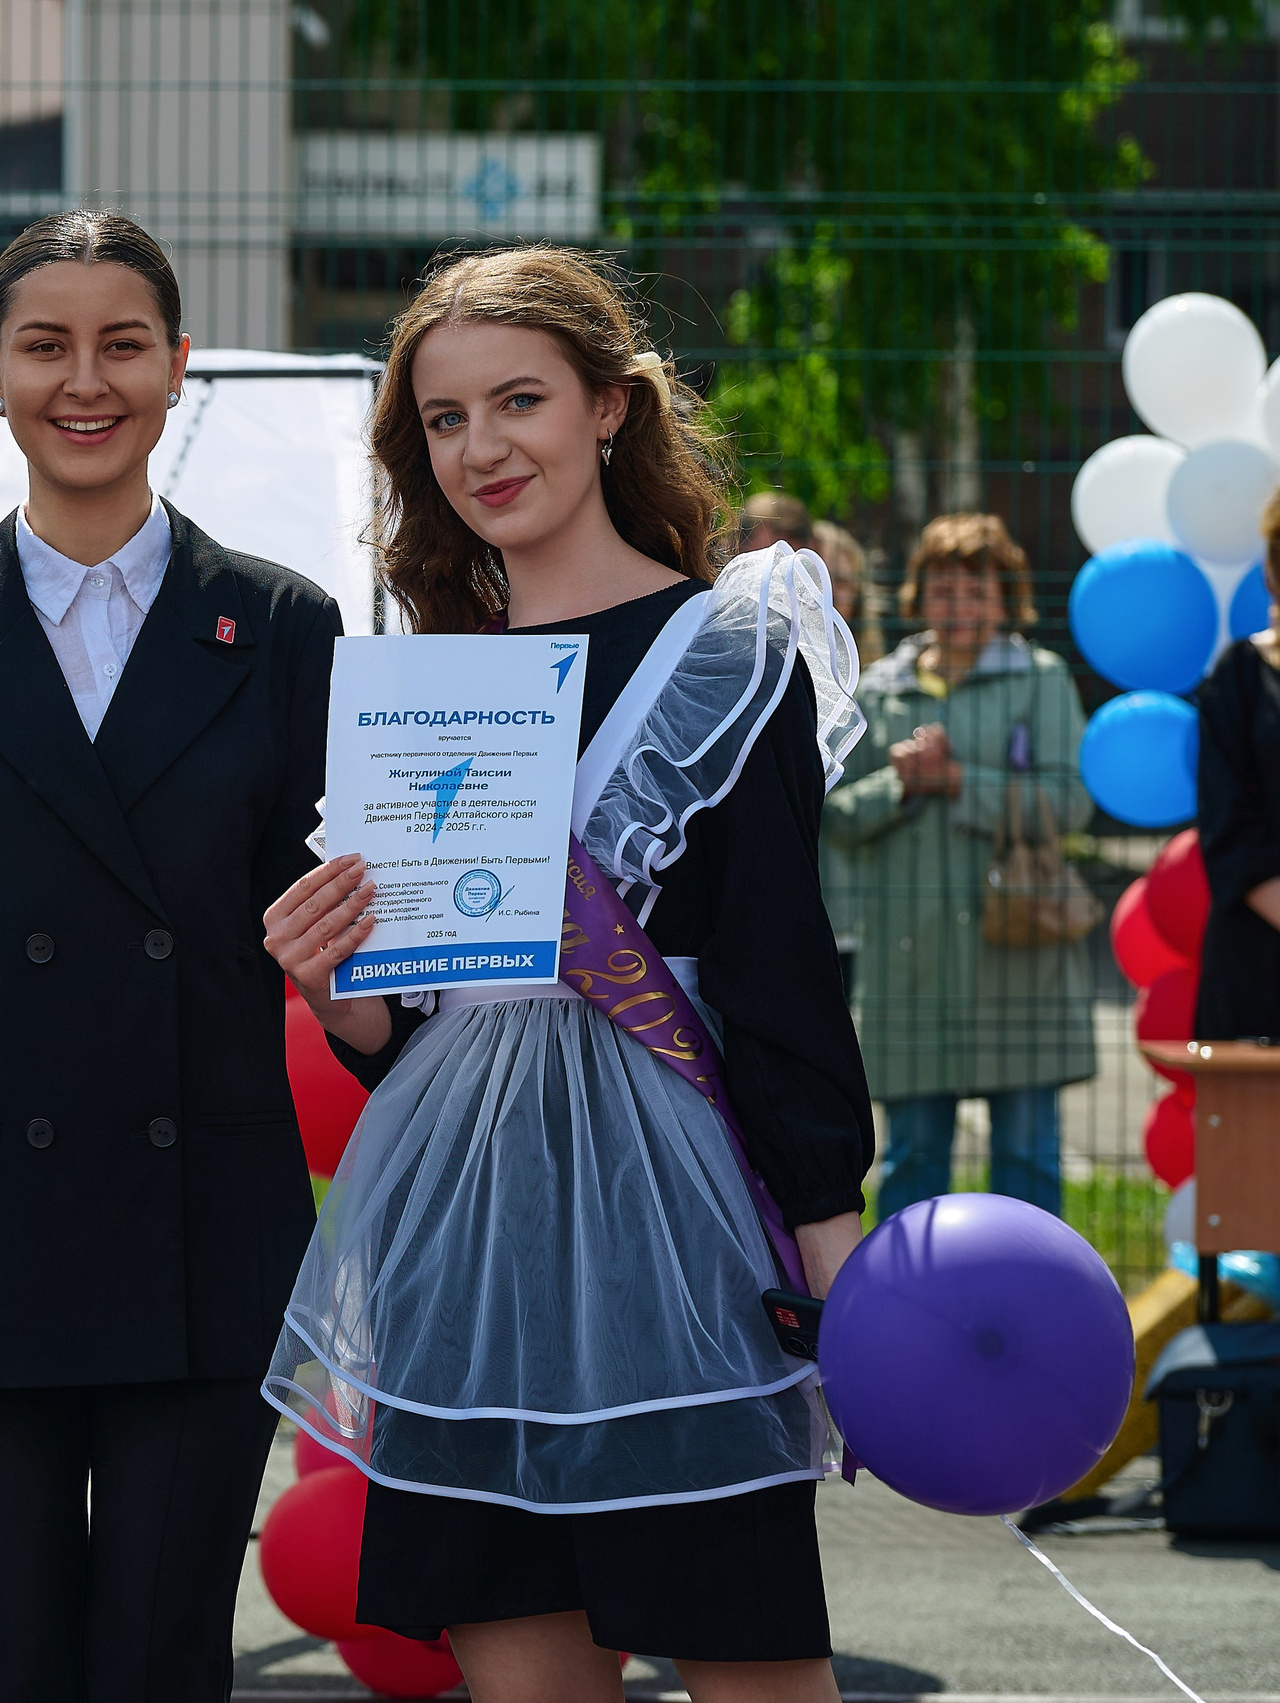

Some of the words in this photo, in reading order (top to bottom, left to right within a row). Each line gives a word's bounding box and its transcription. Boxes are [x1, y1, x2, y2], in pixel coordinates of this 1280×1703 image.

[550, 642, 580, 650] Первые
[358, 710, 556, 728] БЛАГОДАРНОСТЬ
[402, 751, 442, 759] первичного
[442, 750, 477, 758] отделения
[478, 750, 512, 758] Движения
[389, 768, 462, 780] Жигулиной
[465, 768, 512, 778] Таисии
[409, 782, 489, 791] Николаевне
[376, 800, 419, 810] активное
[421, 800, 459, 810] участие
[461, 800, 467, 808] в
[469, 799, 537, 809] деятельности
[364, 813, 412, 824] Движения
[414, 811, 450, 822] Первых
[452, 810, 509, 820] Алтайского
[510, 811, 533, 820] края
[414, 824, 437, 833] 2024
[446, 822, 470, 832] 2025
[472, 823, 487, 831] г.г.
[366, 860, 400, 870] Вместе!
[401, 858, 423, 867] Быть
[430, 856, 479, 867] Движении!
[481, 855, 504, 864] Быть
[505, 855, 550, 865] Первыми!
[402, 880, 449, 889] регионального
[373, 889, 424, 898] бщероссийского
[367, 896, 432, 907] но-государственного
[366, 908, 382, 916] детей
[388, 906, 420, 914] молодежи
[427, 930, 443, 939] 2025
[444, 930, 457, 938] год
[351, 957, 449, 982] ДВИЖЕНИЕ
[452, 954, 535, 971] ПЕРВЫХ
